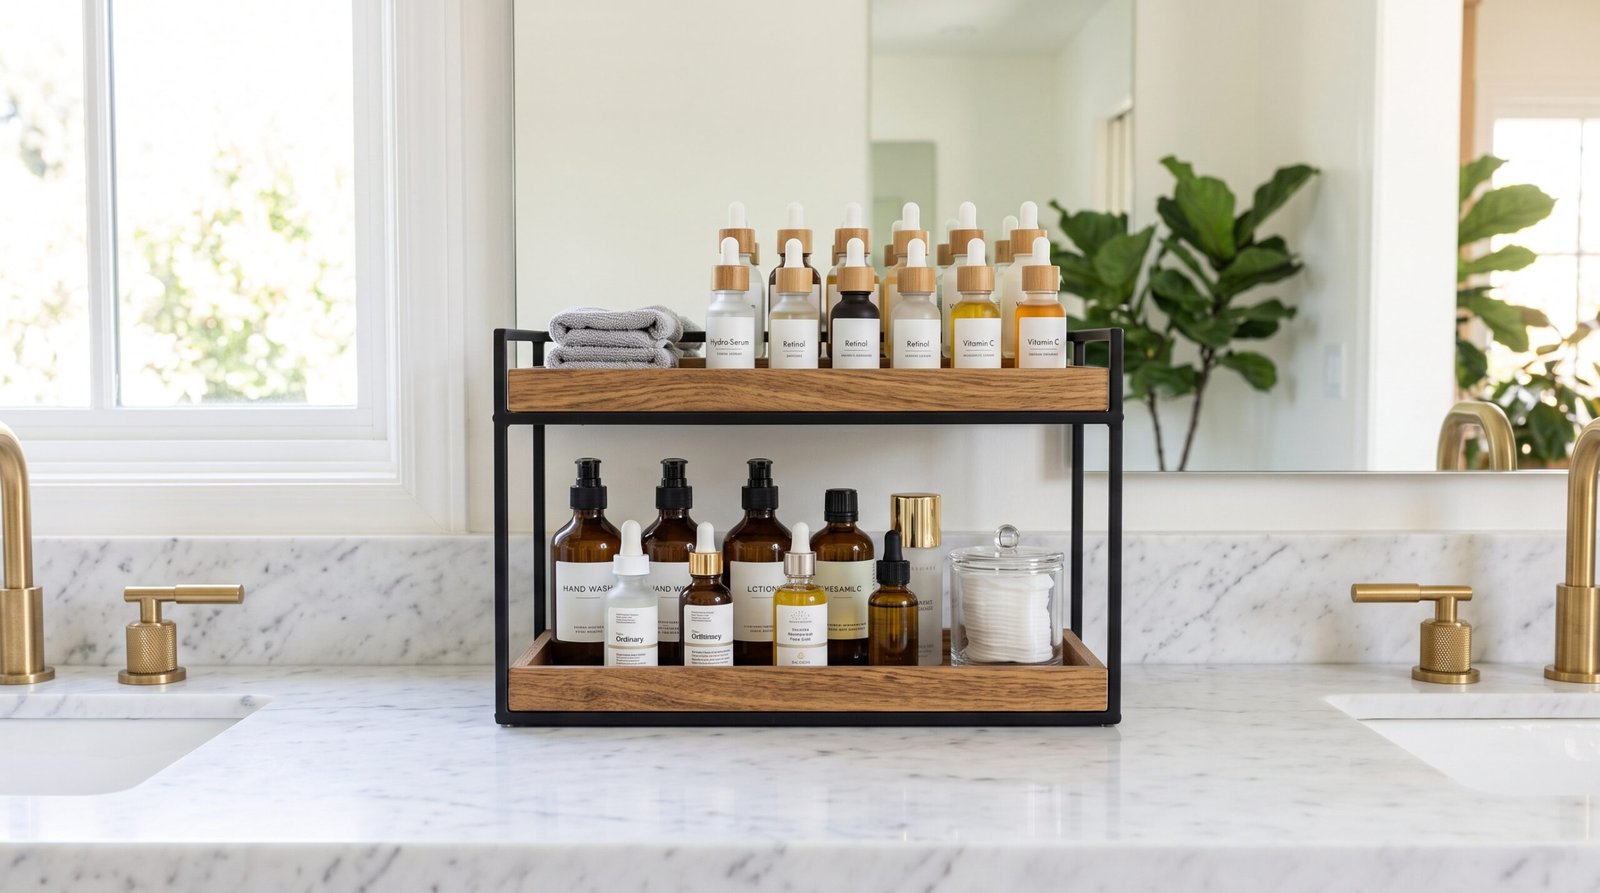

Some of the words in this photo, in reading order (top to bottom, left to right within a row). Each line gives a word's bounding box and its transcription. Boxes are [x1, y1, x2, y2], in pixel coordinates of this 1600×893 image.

[783, 340, 806, 348] Retinol
[845, 339, 868, 347] Retinol
[906, 340, 930, 348] Retinol
[962, 339, 988, 347] Vitamin
[989, 339, 995, 347] C
[1027, 338, 1054, 346] Vitamin
[1054, 338, 1060, 346] C
[615, 635, 644, 643] Ordinary
